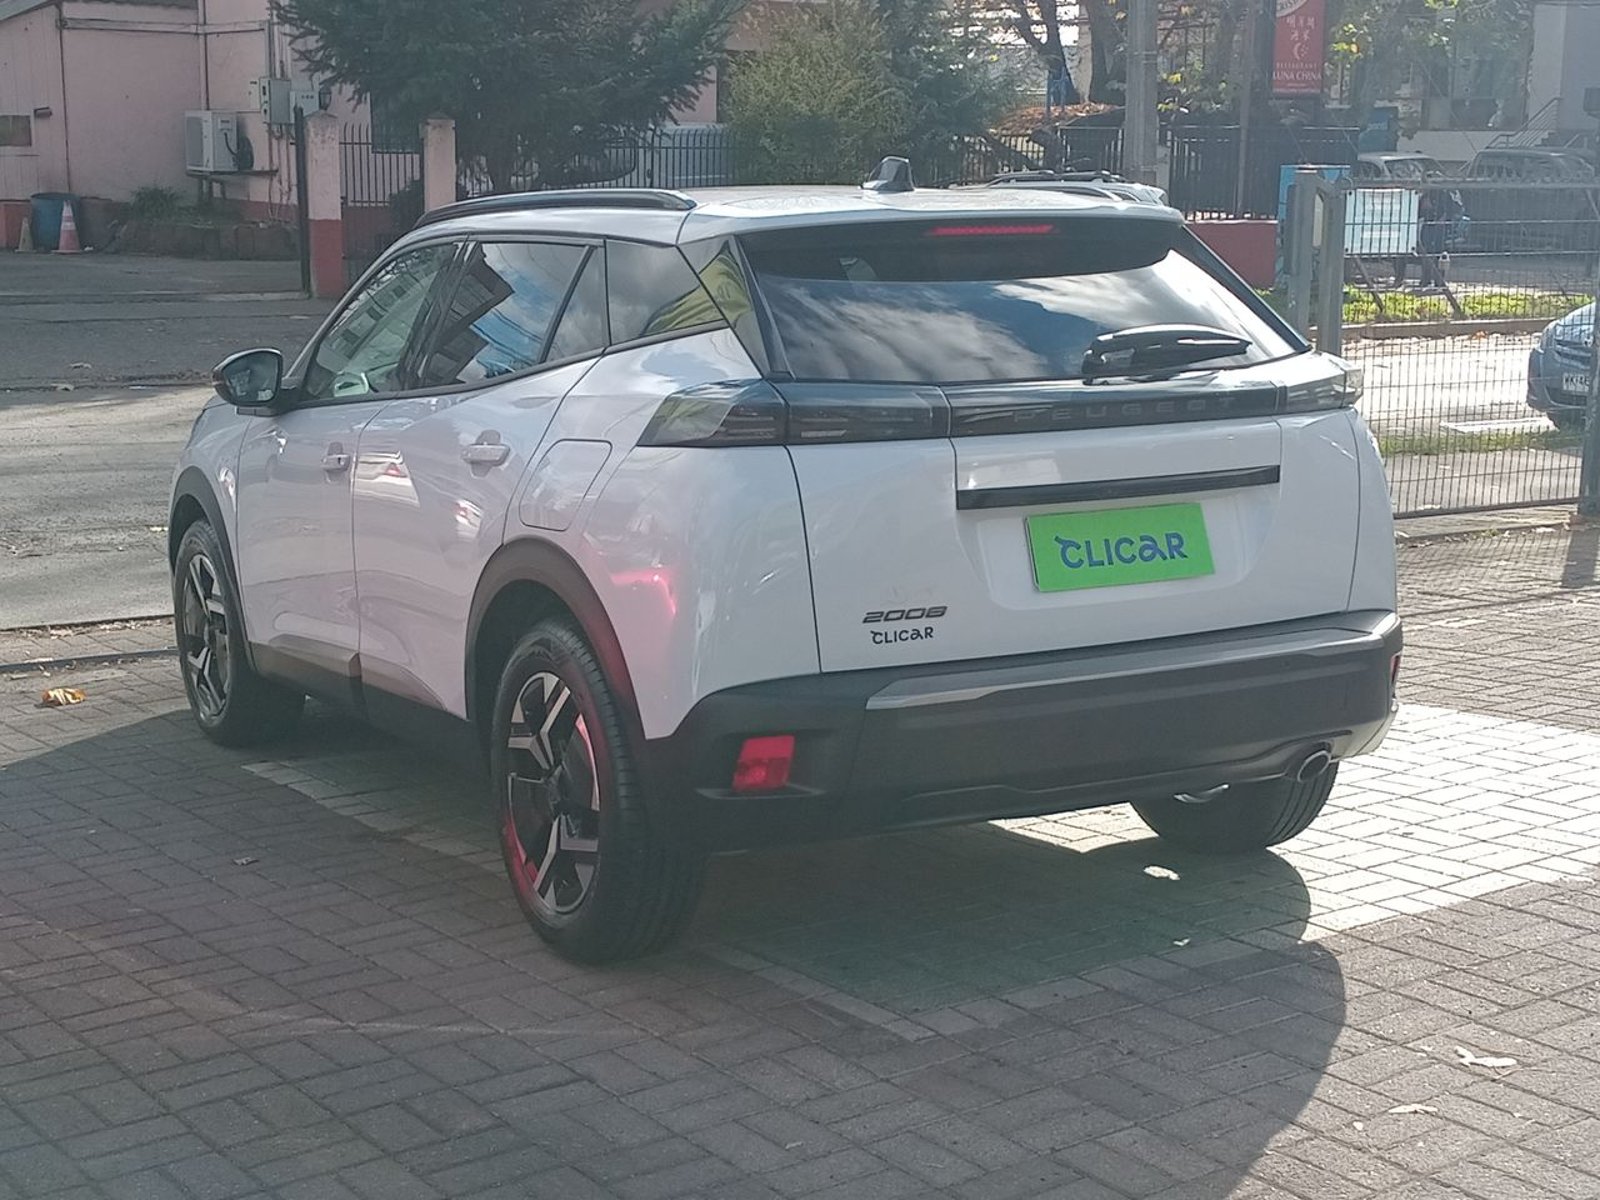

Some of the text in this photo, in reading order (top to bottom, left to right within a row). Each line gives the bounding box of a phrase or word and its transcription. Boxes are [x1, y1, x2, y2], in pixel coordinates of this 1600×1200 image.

[1272, 71, 1321, 80] LUNA CHINA
[1014, 397, 1235, 422] PEUGEOT
[862, 606, 948, 623] 2008
